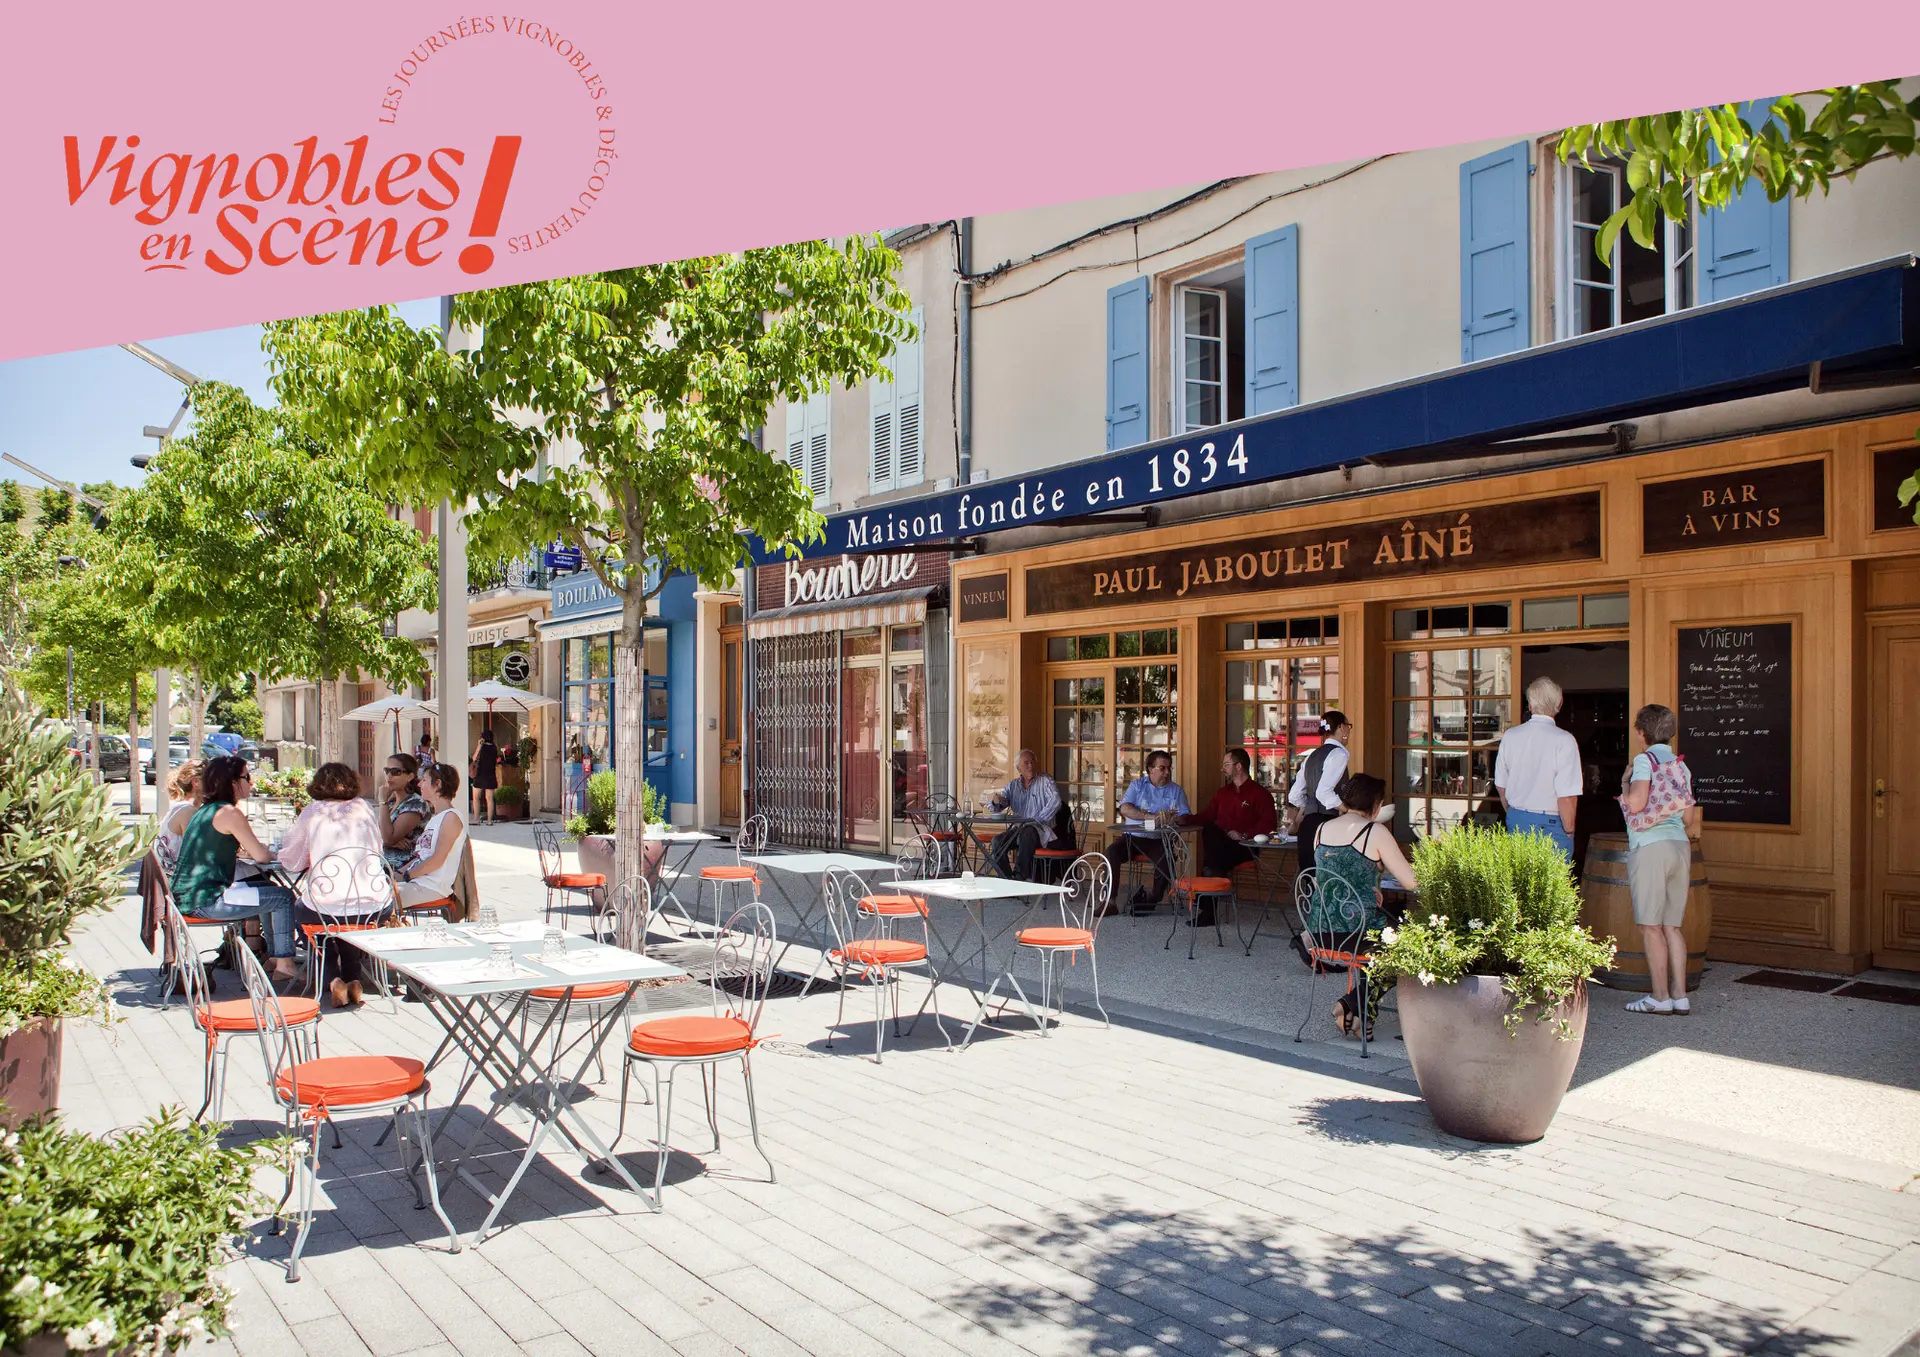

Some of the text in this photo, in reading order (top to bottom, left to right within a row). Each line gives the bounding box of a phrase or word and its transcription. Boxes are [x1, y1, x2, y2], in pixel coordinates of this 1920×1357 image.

[846, 433, 1249, 549] Maison fondée en 1834
[1702, 484, 1758, 508] BAR
[1681, 507, 1781, 536] À VINS
[1093, 512, 1474, 597] PAUL JABOULET AÎNÉ
[784, 549, 919, 608] Boucherie
[963, 589, 1006, 606] VINEUM
[468, 626, 510, 644] URISTE
[1699, 629, 1754, 649] VINEUM
